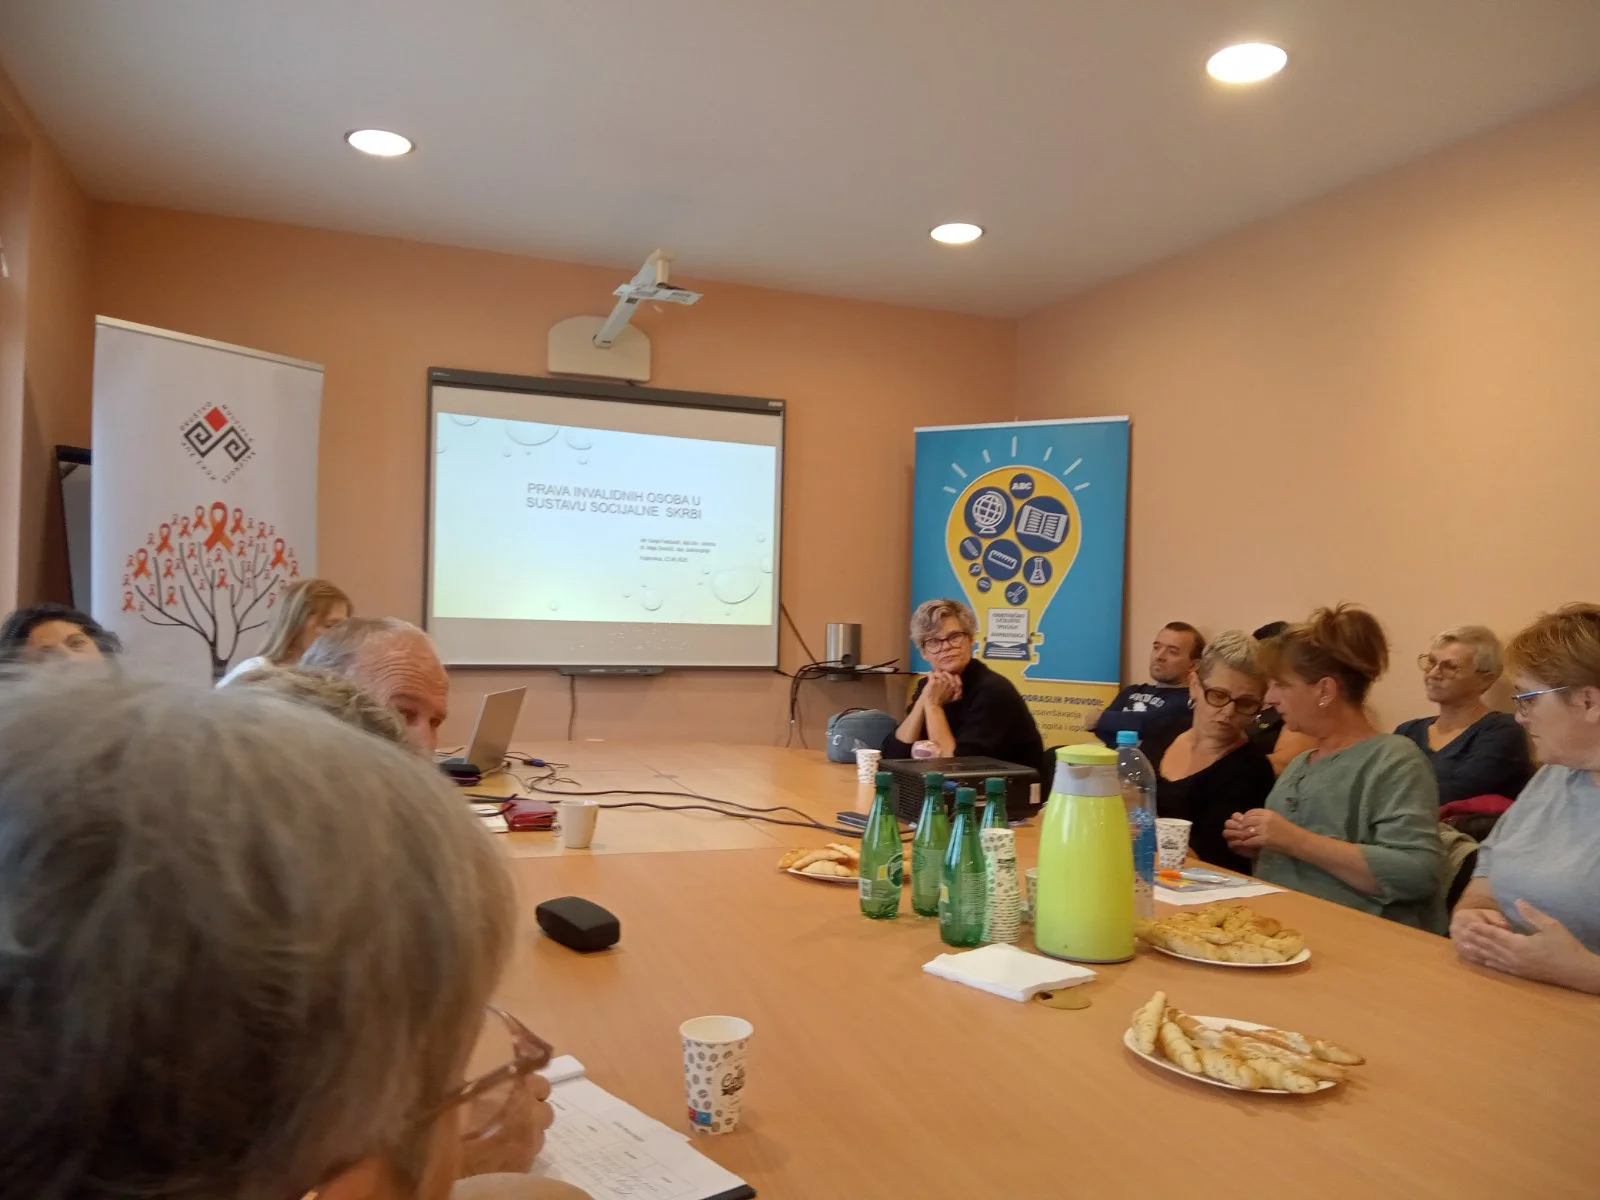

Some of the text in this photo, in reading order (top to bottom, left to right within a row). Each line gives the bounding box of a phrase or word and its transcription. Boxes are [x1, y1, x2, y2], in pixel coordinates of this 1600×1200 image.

[527, 482, 702, 507] PRAVA INVALIDNIH OSOBA U
[1011, 481, 1033, 491] ABC
[526, 496, 703, 520] SUSTAVU SOCIJALNE SKRBI
